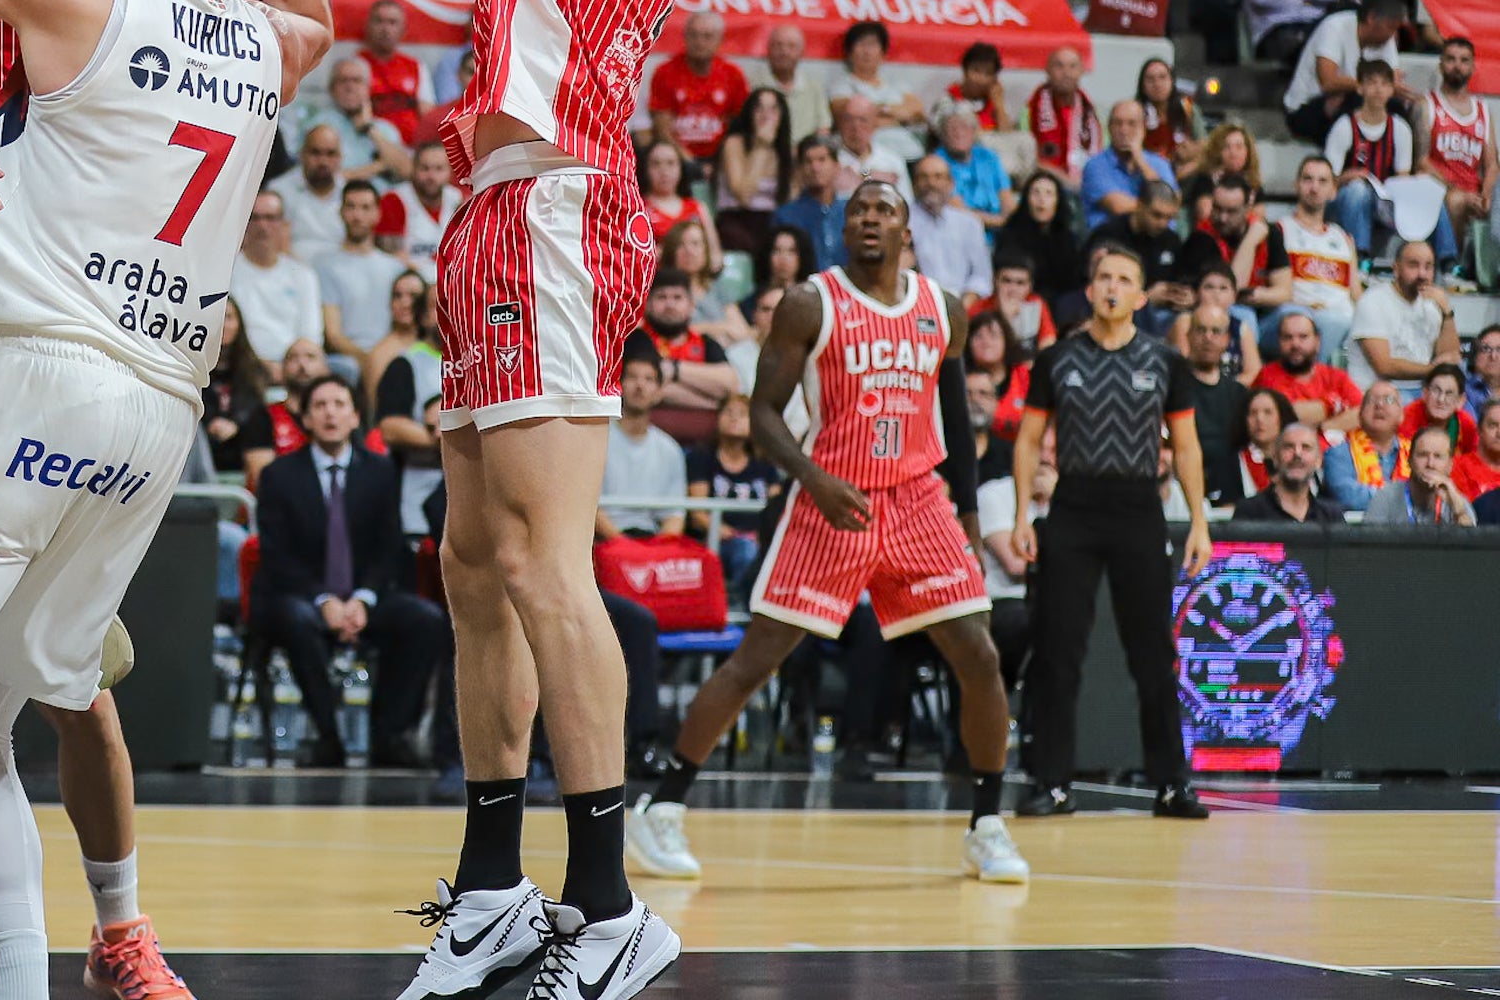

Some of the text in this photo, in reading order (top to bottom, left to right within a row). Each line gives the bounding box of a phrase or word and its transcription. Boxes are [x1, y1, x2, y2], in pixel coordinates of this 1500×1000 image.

[172, 2, 262, 62] KURUCS
[186, 57, 209, 71] GRUPO
[176, 68, 279, 121] AMUTIO
[153, 119, 237, 248] 7
[84, 251, 188, 305] araba
[118, 294, 208, 352] álava
[491, 310, 515, 323] acb
[844, 338, 940, 377] UCAM
[861, 370, 924, 393] MURCIA
[872, 417, 902, 460] 31
